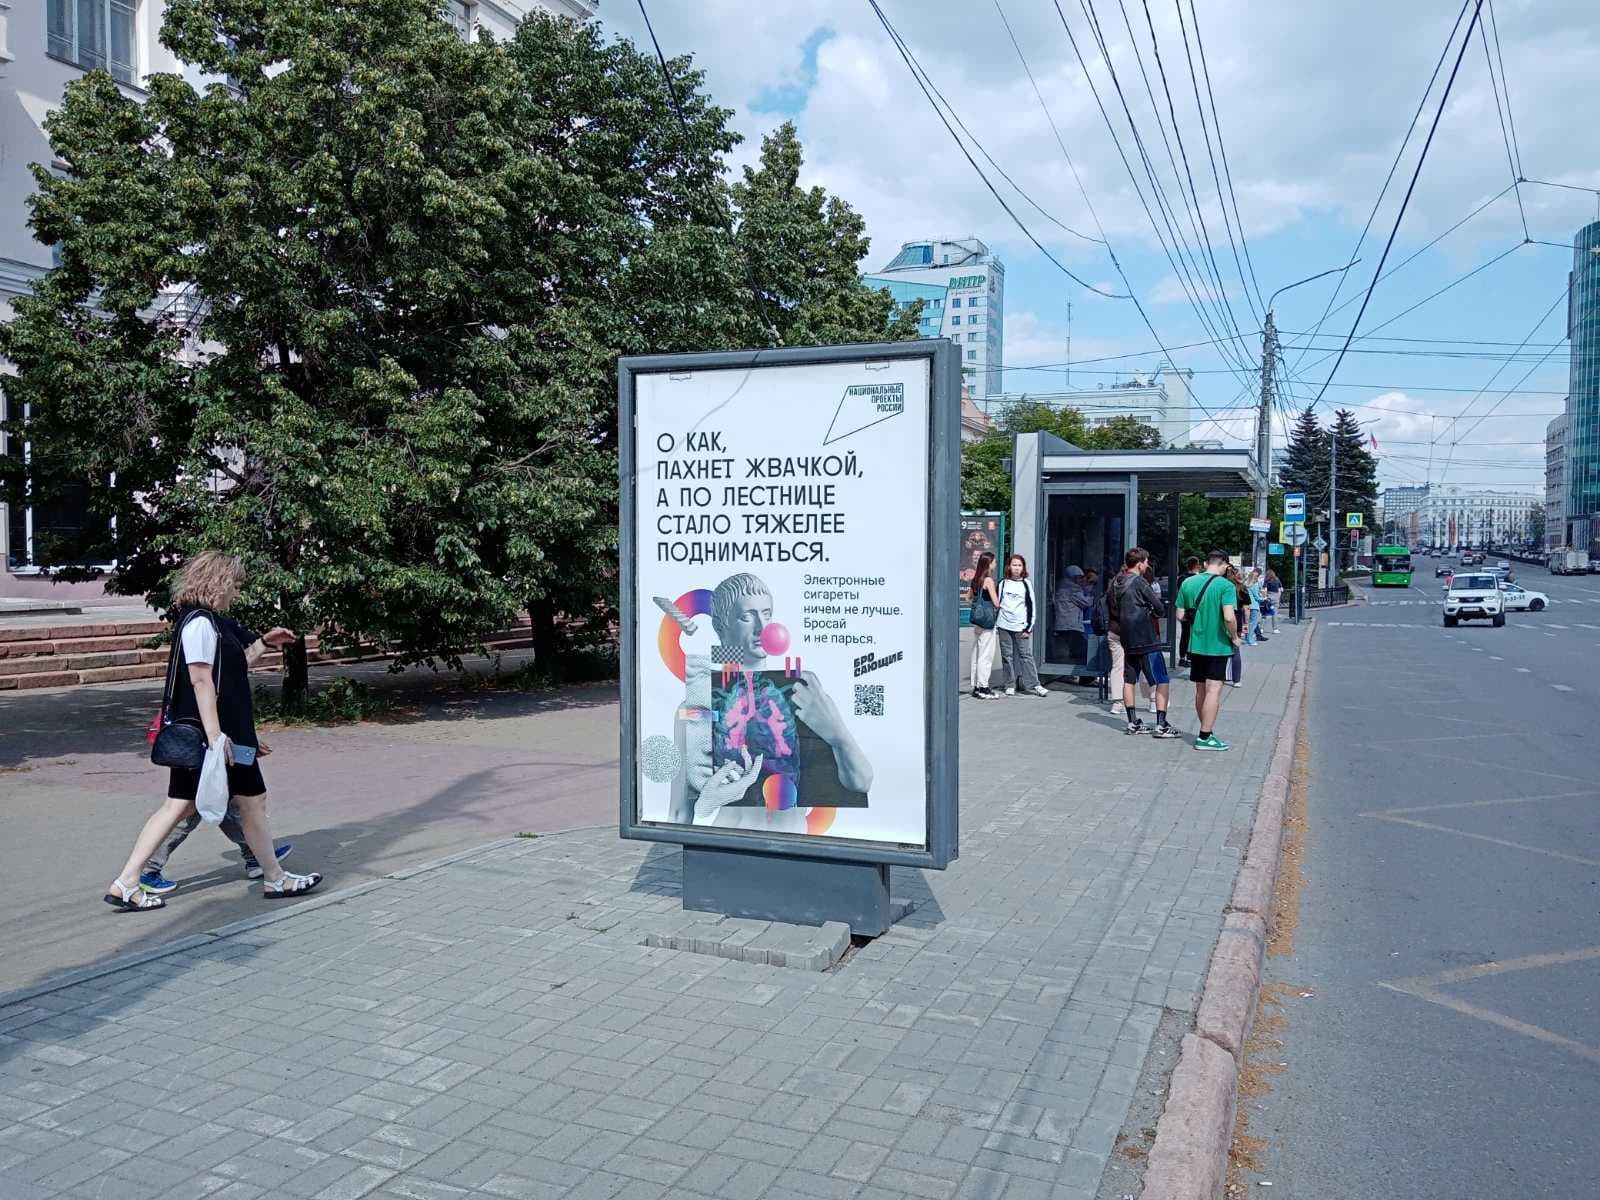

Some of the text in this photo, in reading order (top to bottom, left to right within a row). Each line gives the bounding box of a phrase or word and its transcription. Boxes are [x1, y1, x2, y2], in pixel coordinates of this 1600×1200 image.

[849, 385, 902, 396] НАЦИОНАЛЬНЫЕ
[871, 394, 902, 403] ПРОЕКТЫ
[876, 403, 902, 412] РОССИИ
[657, 432, 726, 453] О КАК,
[658, 451, 863, 479] ПАХНЕТ ЖВАЧКОЙ,
[657, 485, 835, 509] А ПО ЛЕСТНИЦЕ
[657, 513, 844, 534] СТАЛО ТЯЖЕЛЕЕ
[658, 542, 829, 565] ПОДНИМАТЬСЯ.
[804, 574, 885, 587] Электронные
[804, 590, 859, 601] сигареты
[803, 605, 904, 617] ничем не лучше.
[804, 618, 846, 630] Бросай
[803, 634, 877, 646] и не парься.
[854, 652, 875, 668] БРО
[854, 650, 903, 678] САЮЩИЕ
